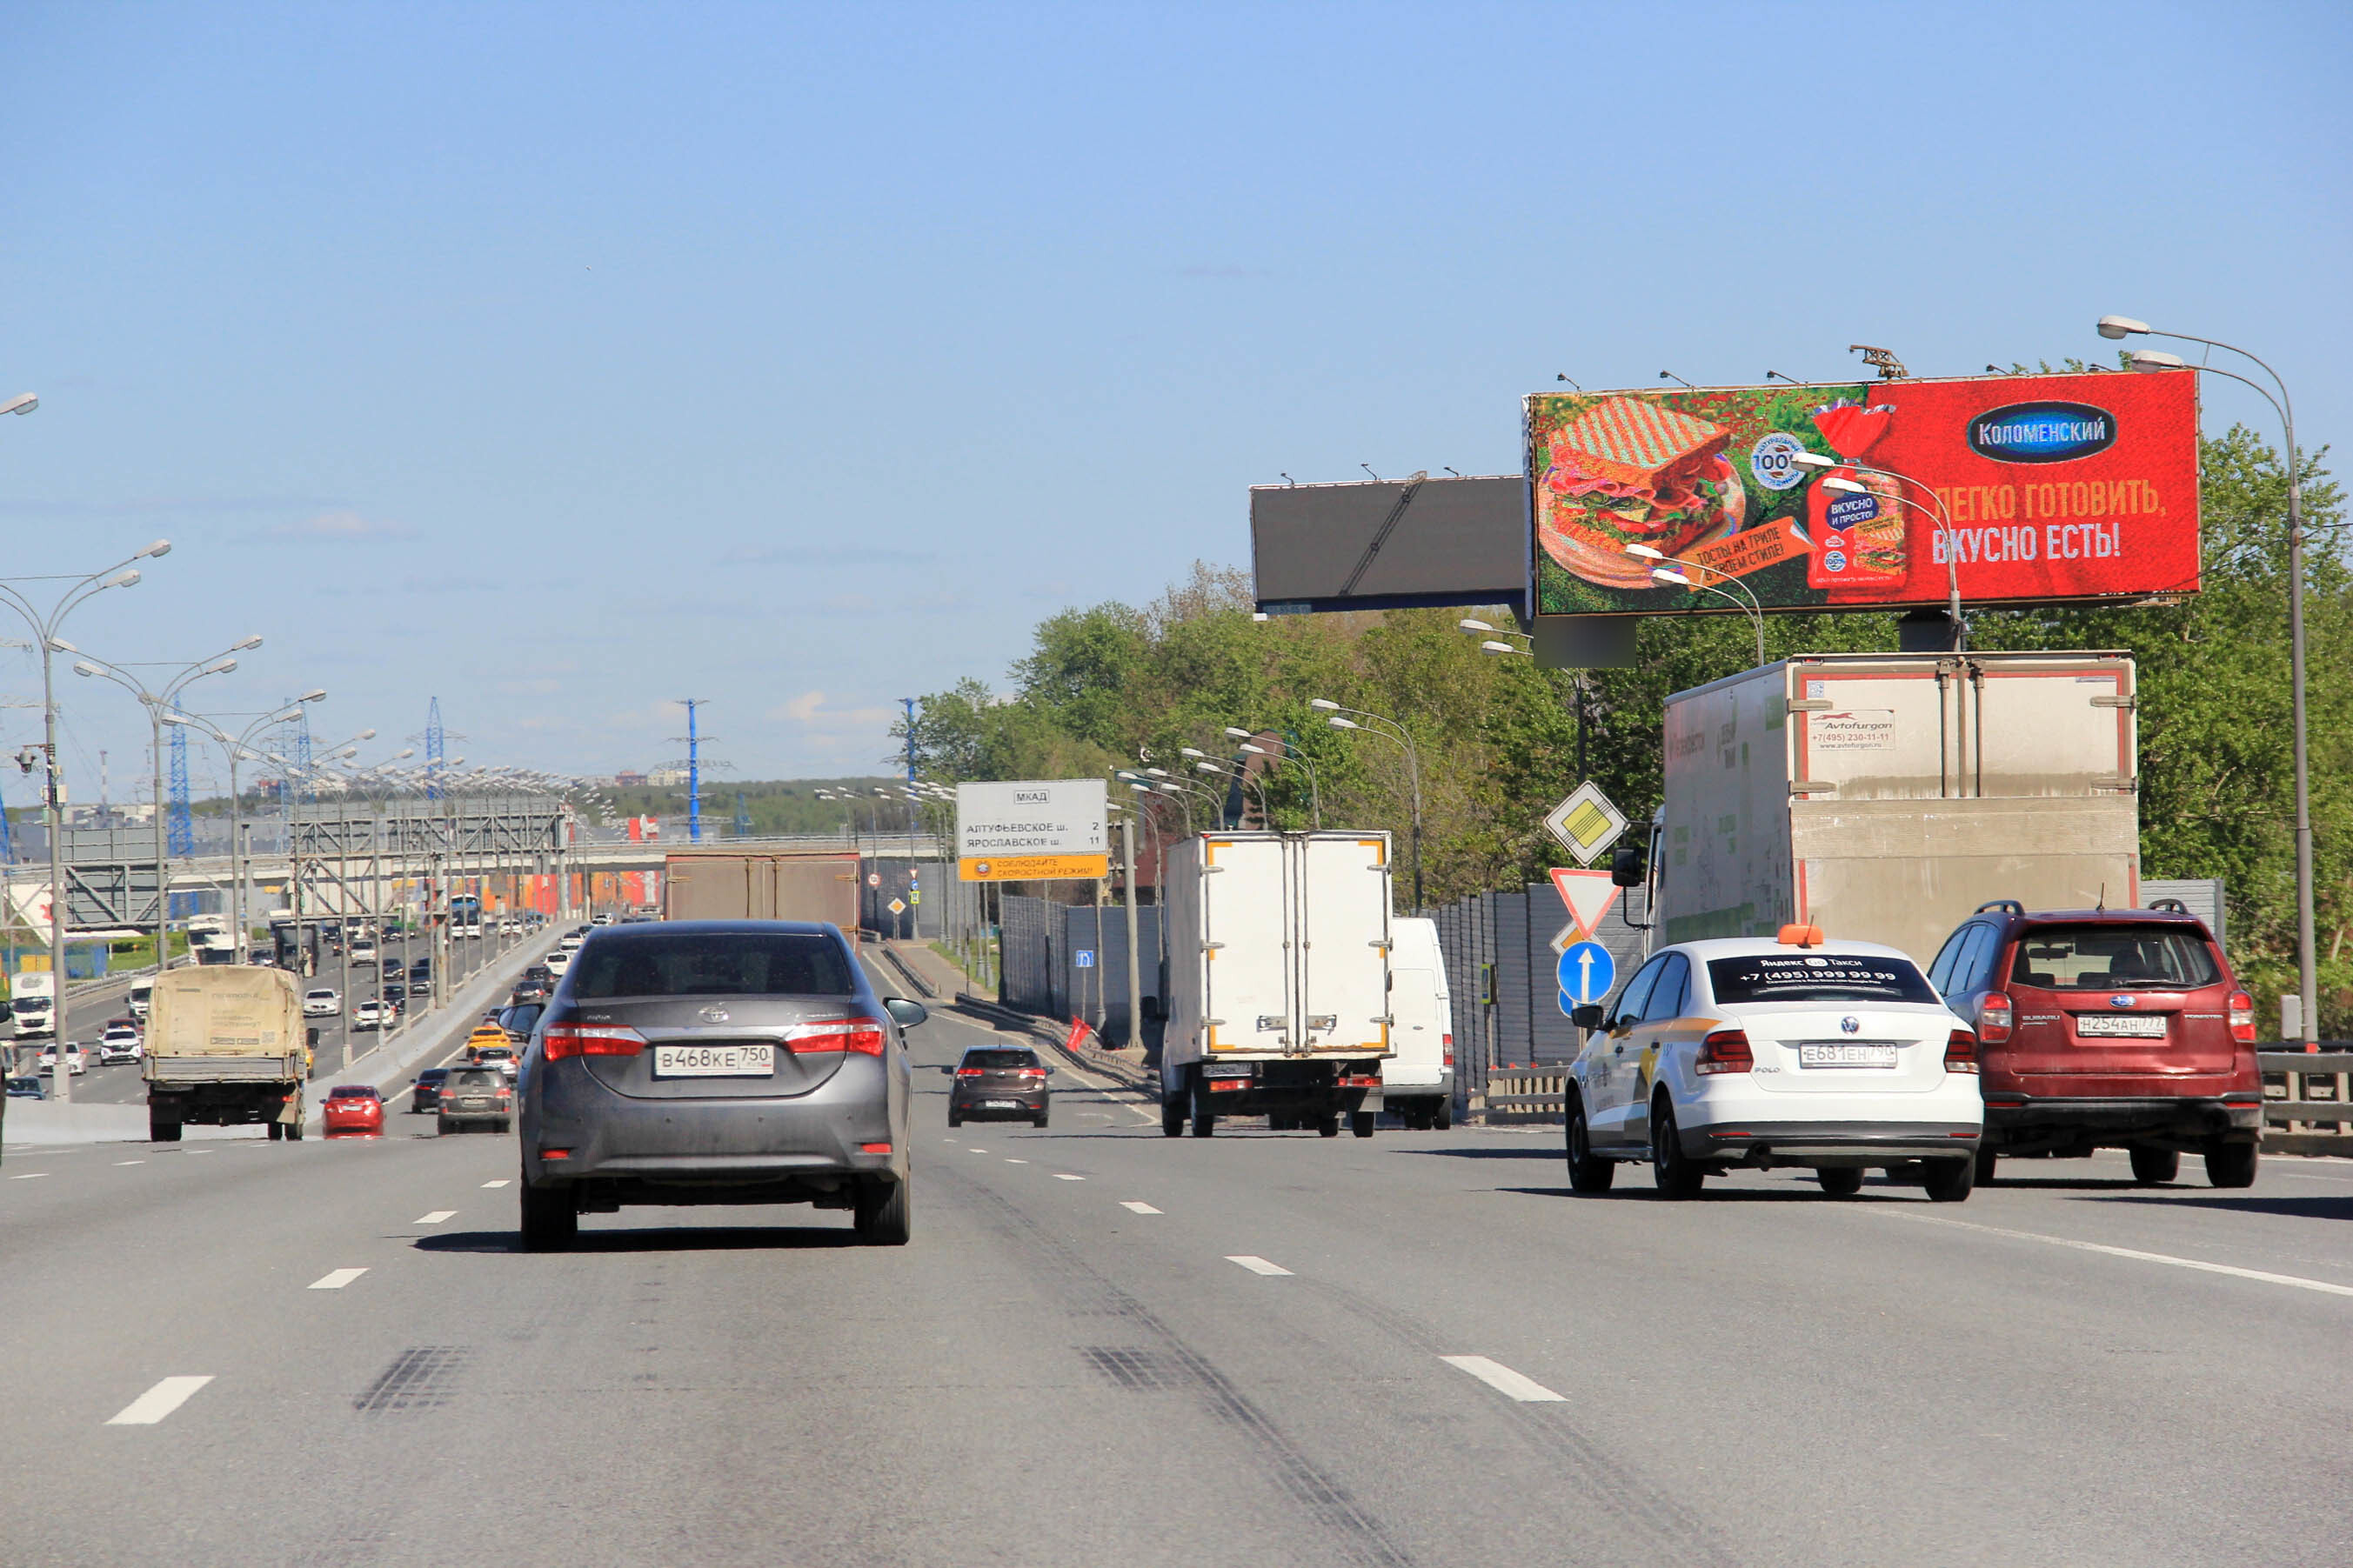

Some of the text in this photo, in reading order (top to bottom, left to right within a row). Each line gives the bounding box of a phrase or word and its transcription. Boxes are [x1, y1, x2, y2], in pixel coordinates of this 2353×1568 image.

[1831, 497, 1873, 515] ВКУСНО
[1932, 479, 2166, 522] ЛЕГКО ГОТОВИТЬ,
[1840, 510, 1873, 524] ПРОСТО!
[1696, 527, 1781, 565] ТОСТЫ НА ГРИЛЕ
[1932, 523, 2121, 564] ВКУСНО ЕСТЬ!
[1748, 544, 1784, 564] СТИЛЕ!
[1824, 722, 1893, 731] Avtofurgon
[1812, 733, 1845, 742] +7(495)
[1016, 792, 1046, 802] МКАД
[966, 822, 1053, 833] АЛТУФЬЕВСКОЕ
[1093, 822, 1099, 831] 2
[966, 837, 1047, 848] ЯРОСЛАВСКОЕ
[997, 858, 1059, 868] СОБЛЮДАЙТЕ
[997, 868, 1057, 877] СКОРОСТНОЙ
[1764, 971, 1809, 980] (495)
[662, 1047, 768, 1068] В468КЕ 750
